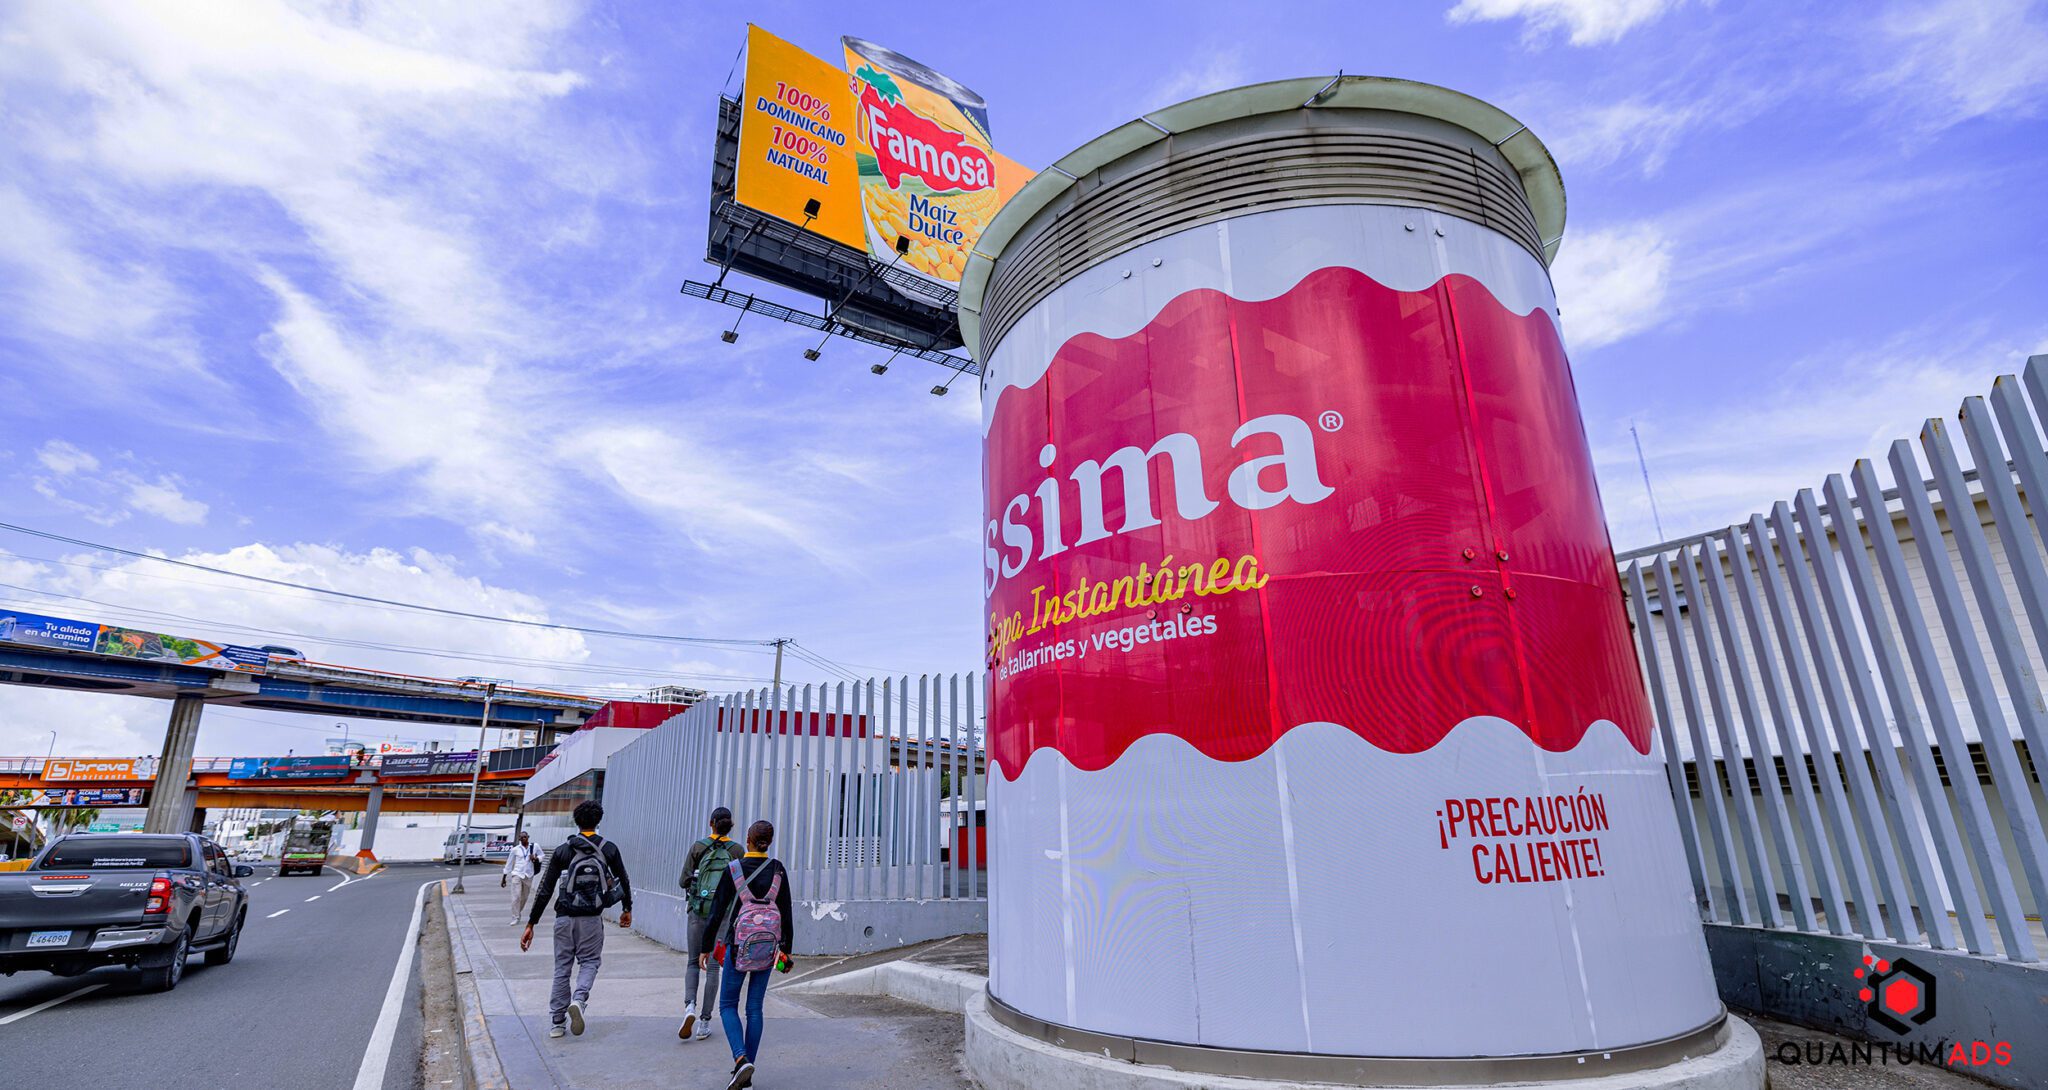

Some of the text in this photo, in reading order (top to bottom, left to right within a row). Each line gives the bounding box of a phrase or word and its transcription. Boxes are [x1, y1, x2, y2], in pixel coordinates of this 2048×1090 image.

[756, 96, 846, 148] DOMINICANO
[775, 81, 831, 123] 100%
[771, 125, 828, 165] 100%
[868, 103, 990, 188] Famosa
[766, 148, 829, 186] NATURAL
[909, 193, 958, 227] Maíz
[908, 216, 964, 246] Dulce
[988, 553, 1270, 662] Sopa Instantánea
[40, 630, 51, 638] el
[52, 632, 91, 643] camino
[45, 622, 92, 636] Tu aliado
[999, 612, 1218, 681] de tallarines y vegetales
[1436, 785, 1610, 850] ¡PRECAUCIÓN
[1471, 837, 1606, 885] CALIENTE!
[30, 934, 69, 944] L464090
